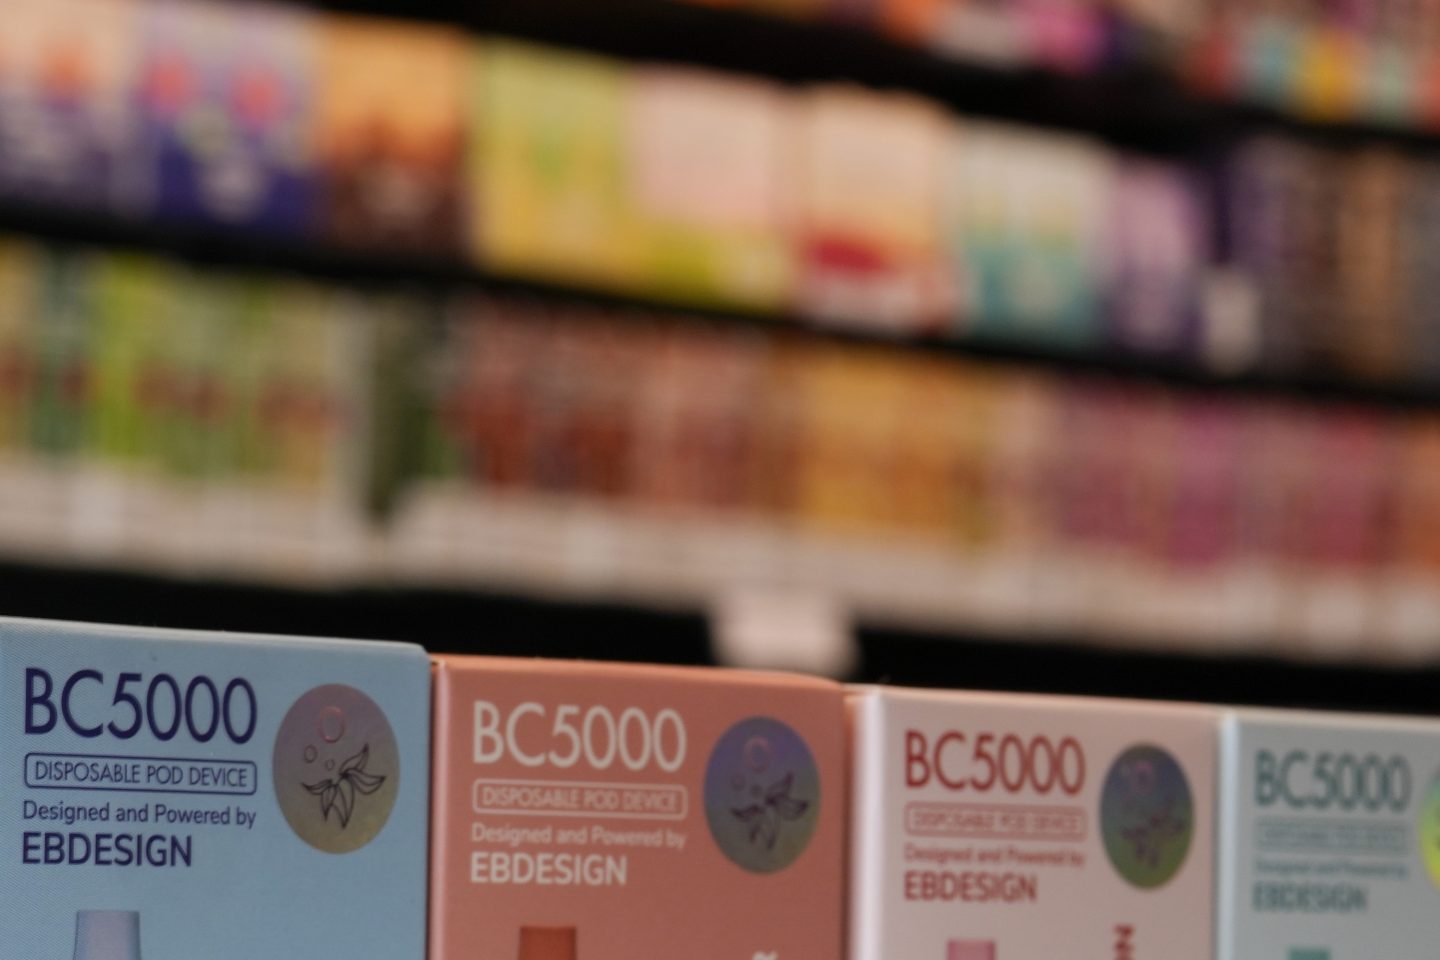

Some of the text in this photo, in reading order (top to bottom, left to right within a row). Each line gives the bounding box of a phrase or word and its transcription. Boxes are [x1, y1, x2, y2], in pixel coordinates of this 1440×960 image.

[24, 667, 258, 744] BC5000
[474, 700, 687, 773] BC5000
[35, 761, 247, 787] DISPOSABLE POD DEVICE
[905, 729, 1086, 796] BC5000
[1254, 748, 1411, 814] BC5000
[23, 800, 256, 830] Designed and Powered by
[22, 831, 192, 867] EBDESIGN
[472, 822, 687, 849] Designed and Powered by
[471, 851, 627, 885] EBDESIGN
[904, 870, 1037, 902] EBDESIGN
